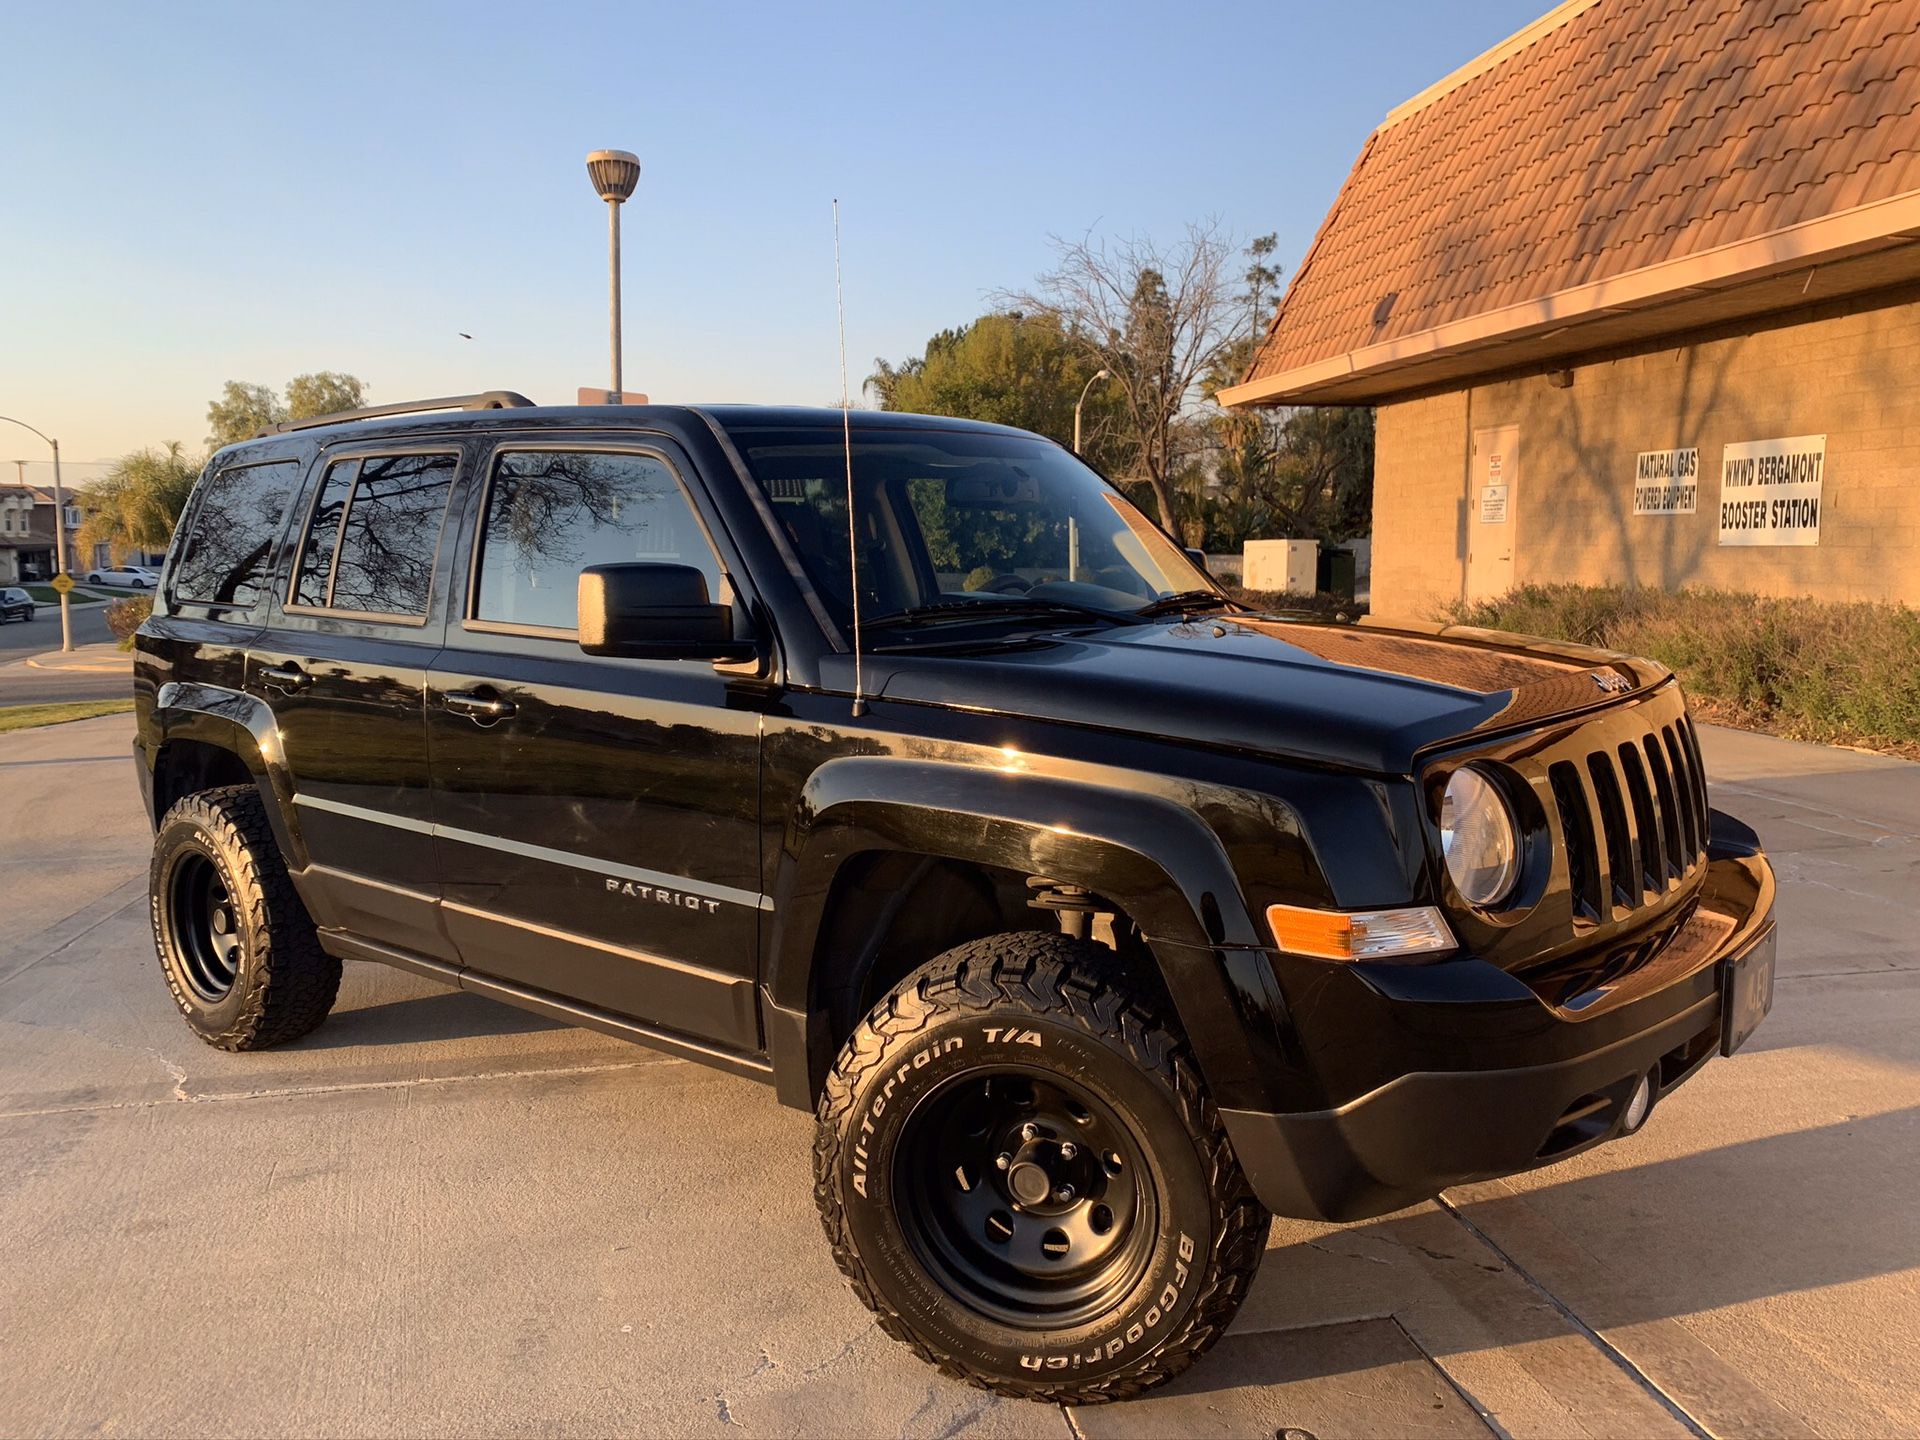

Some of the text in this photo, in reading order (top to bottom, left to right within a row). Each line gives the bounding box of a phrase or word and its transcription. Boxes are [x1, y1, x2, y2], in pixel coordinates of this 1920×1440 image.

[1639, 451, 1697, 479] NATURAL GAS
[1725, 452, 1822, 488] WMWD BERGAMONT
[1634, 484, 1696, 511] POWERED EQUIPMENT
[1721, 498, 1819, 530] BOOSTER STATION
[605, 879, 721, 914] PATRIOT
[852, 1027, 1043, 1200] All-Terrain T/A
[1019, 1230, 1196, 1372] BFGoodrich
